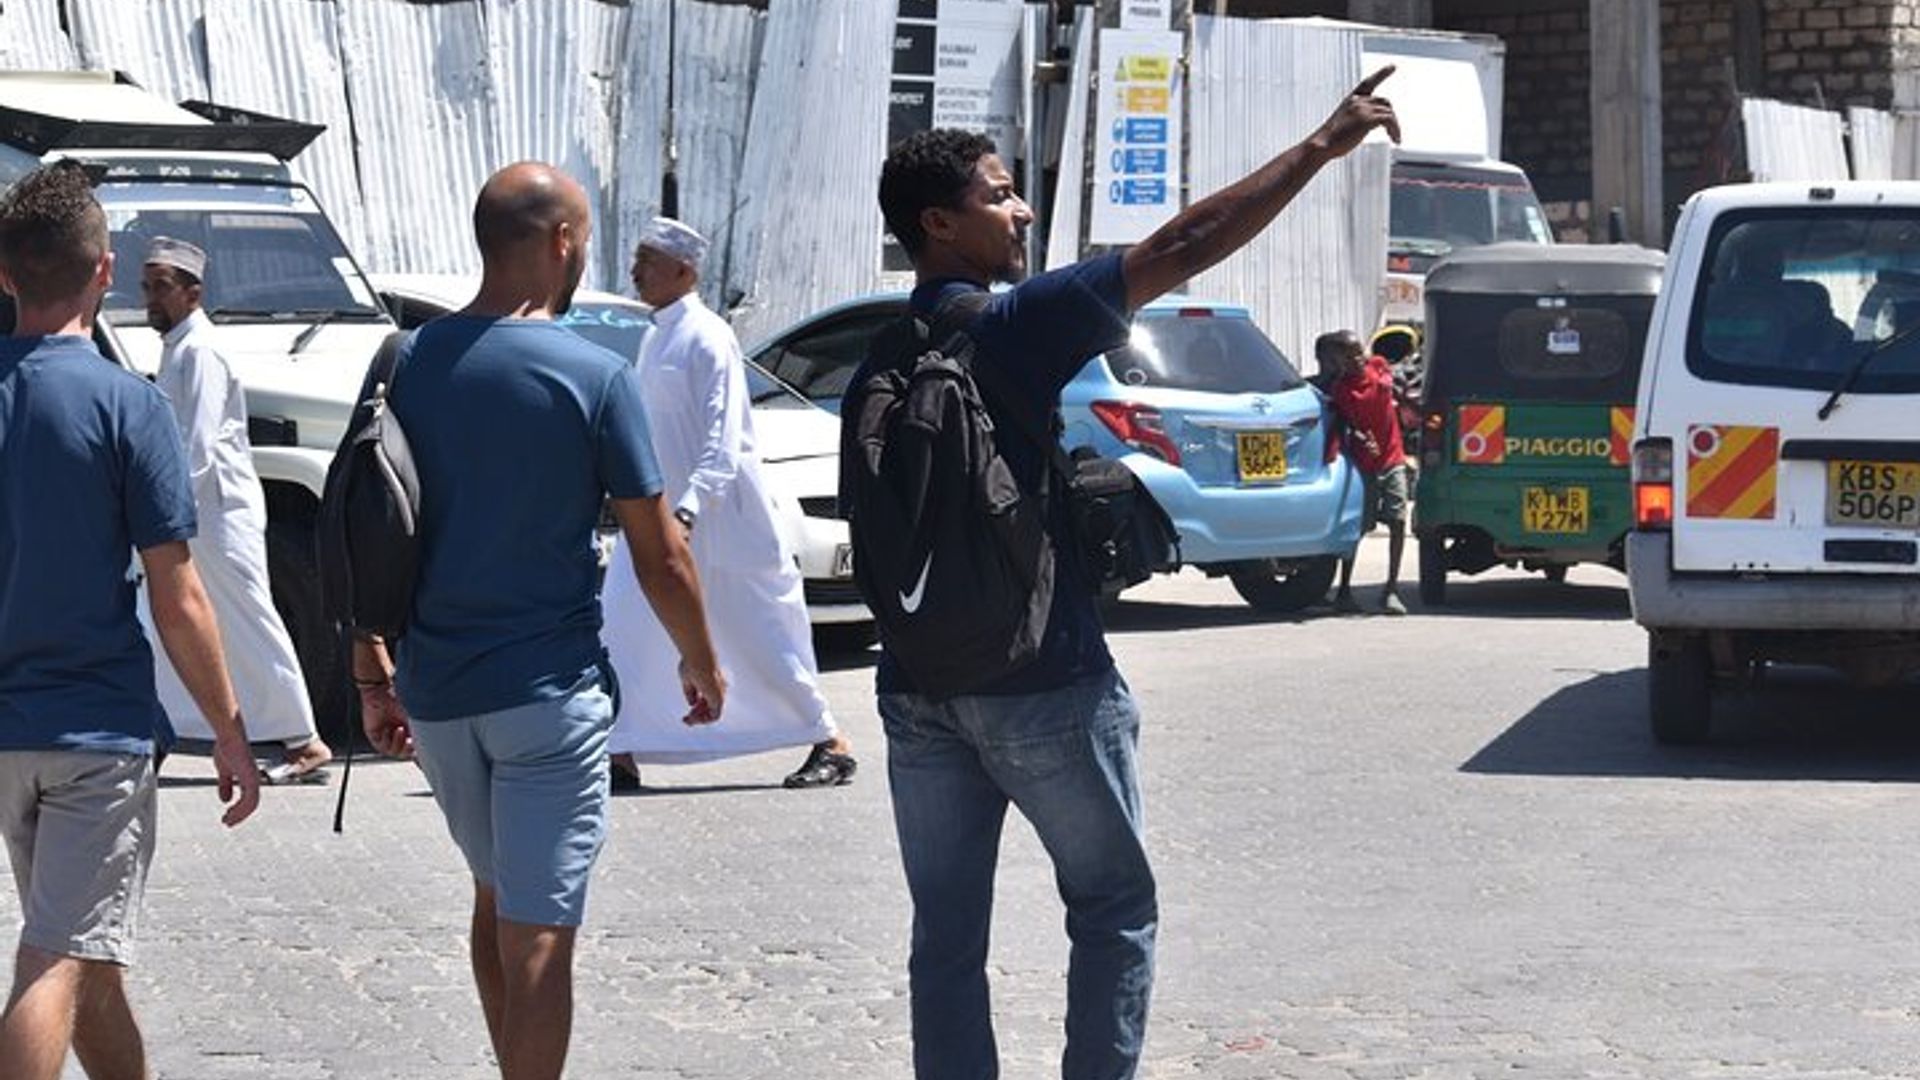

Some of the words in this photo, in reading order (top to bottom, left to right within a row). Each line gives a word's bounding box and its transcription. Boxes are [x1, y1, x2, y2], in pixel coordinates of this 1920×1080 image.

[1505, 438, 1611, 456] PIAGGIO
[1839, 461, 1896, 491] KBS
[1527, 490, 1581, 510] KTWB
[1838, 492, 1915, 522] 506P
[1529, 511, 1583, 530] 127M
